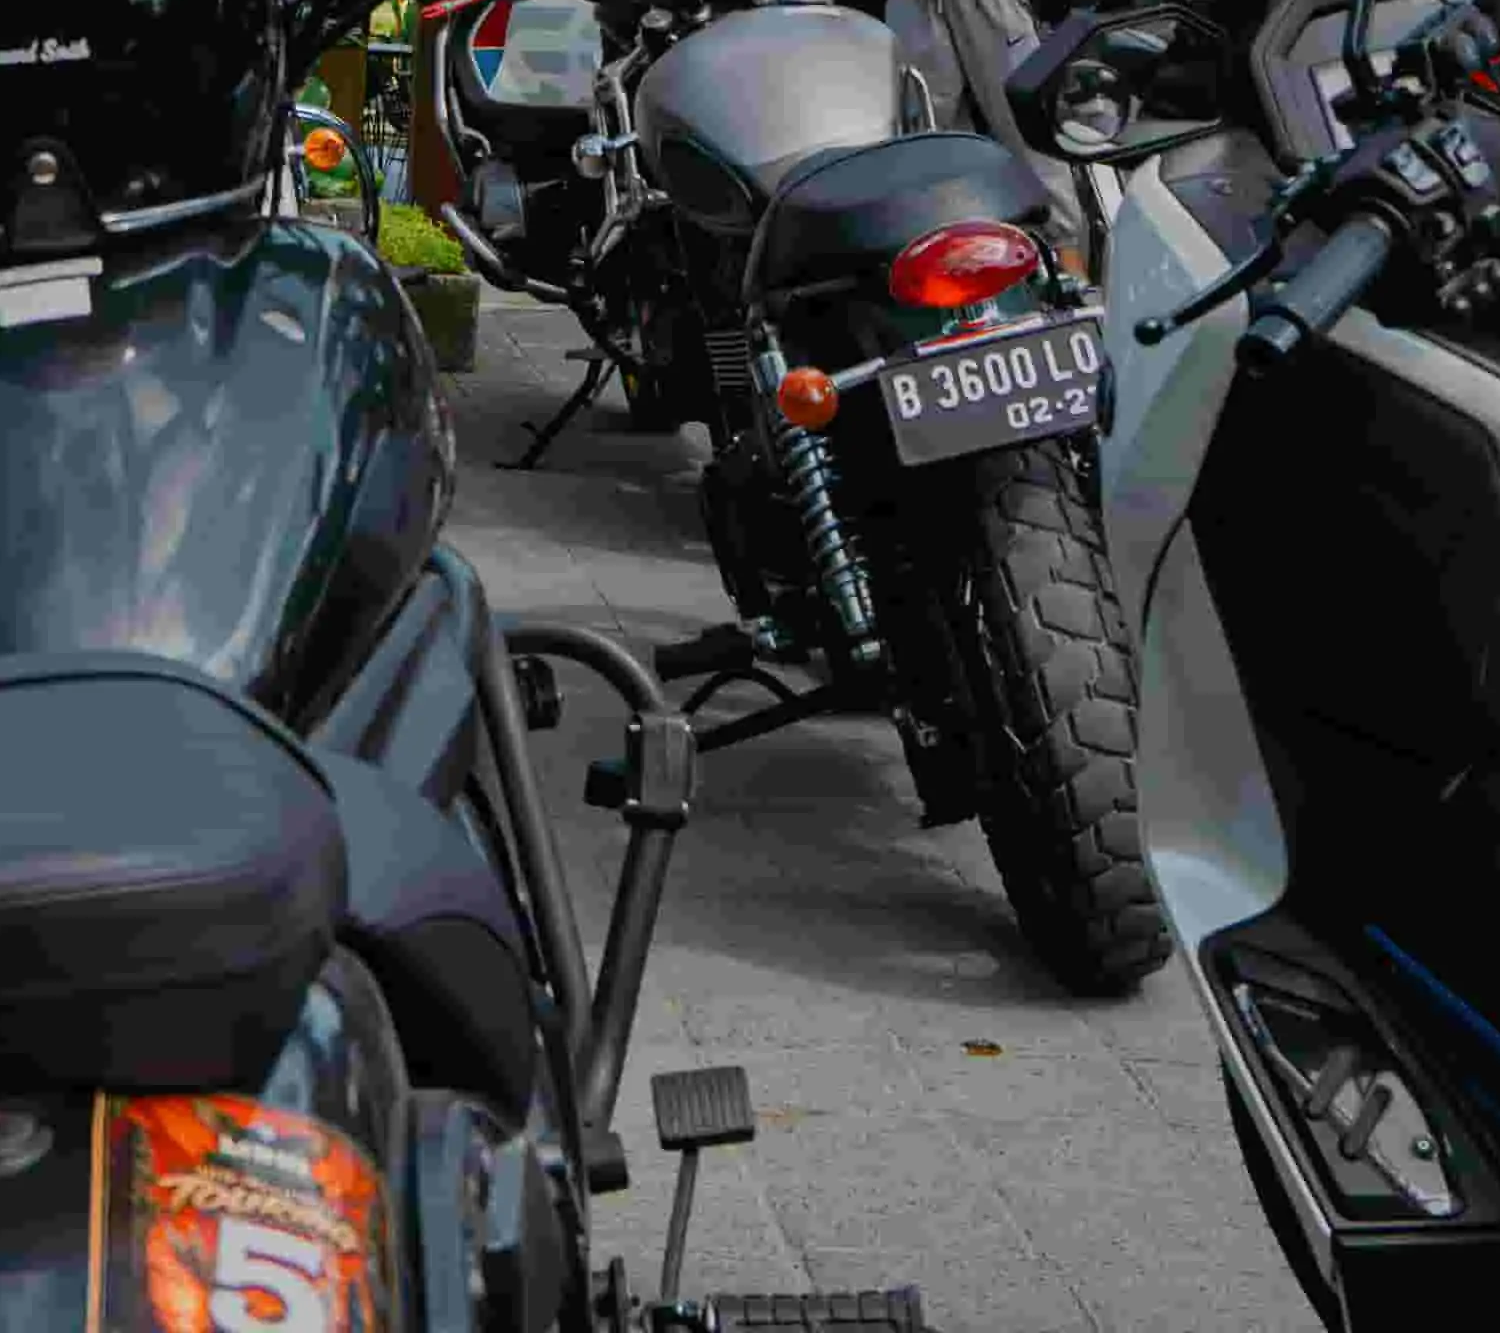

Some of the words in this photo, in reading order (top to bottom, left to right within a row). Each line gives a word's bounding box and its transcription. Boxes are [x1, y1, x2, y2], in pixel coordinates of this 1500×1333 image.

[891, 372, 923, 420] B
[929, 345, 1039, 410] 3600
[208, 1218, 326, 1333] 5
